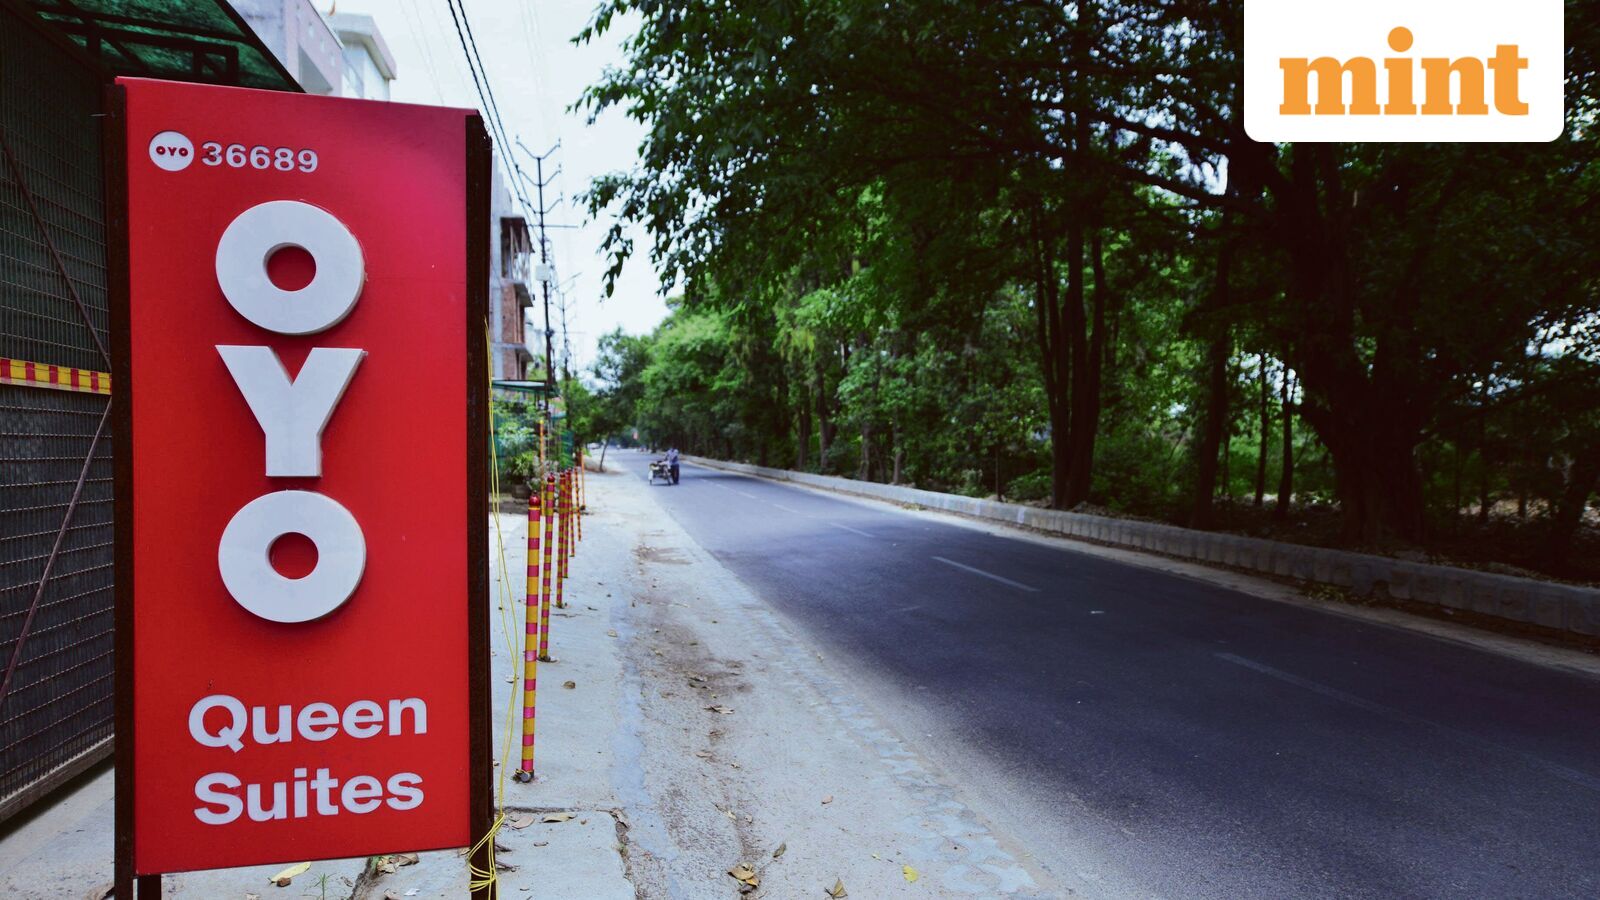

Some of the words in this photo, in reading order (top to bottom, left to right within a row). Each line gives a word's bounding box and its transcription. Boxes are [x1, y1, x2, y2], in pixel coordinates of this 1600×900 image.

[155, 145, 189, 157] OYO
[201, 141, 319, 173] 36689
[214, 199, 366, 623] OYO
[188, 694, 427, 753] Queen
[193, 767, 425, 825] Suites
